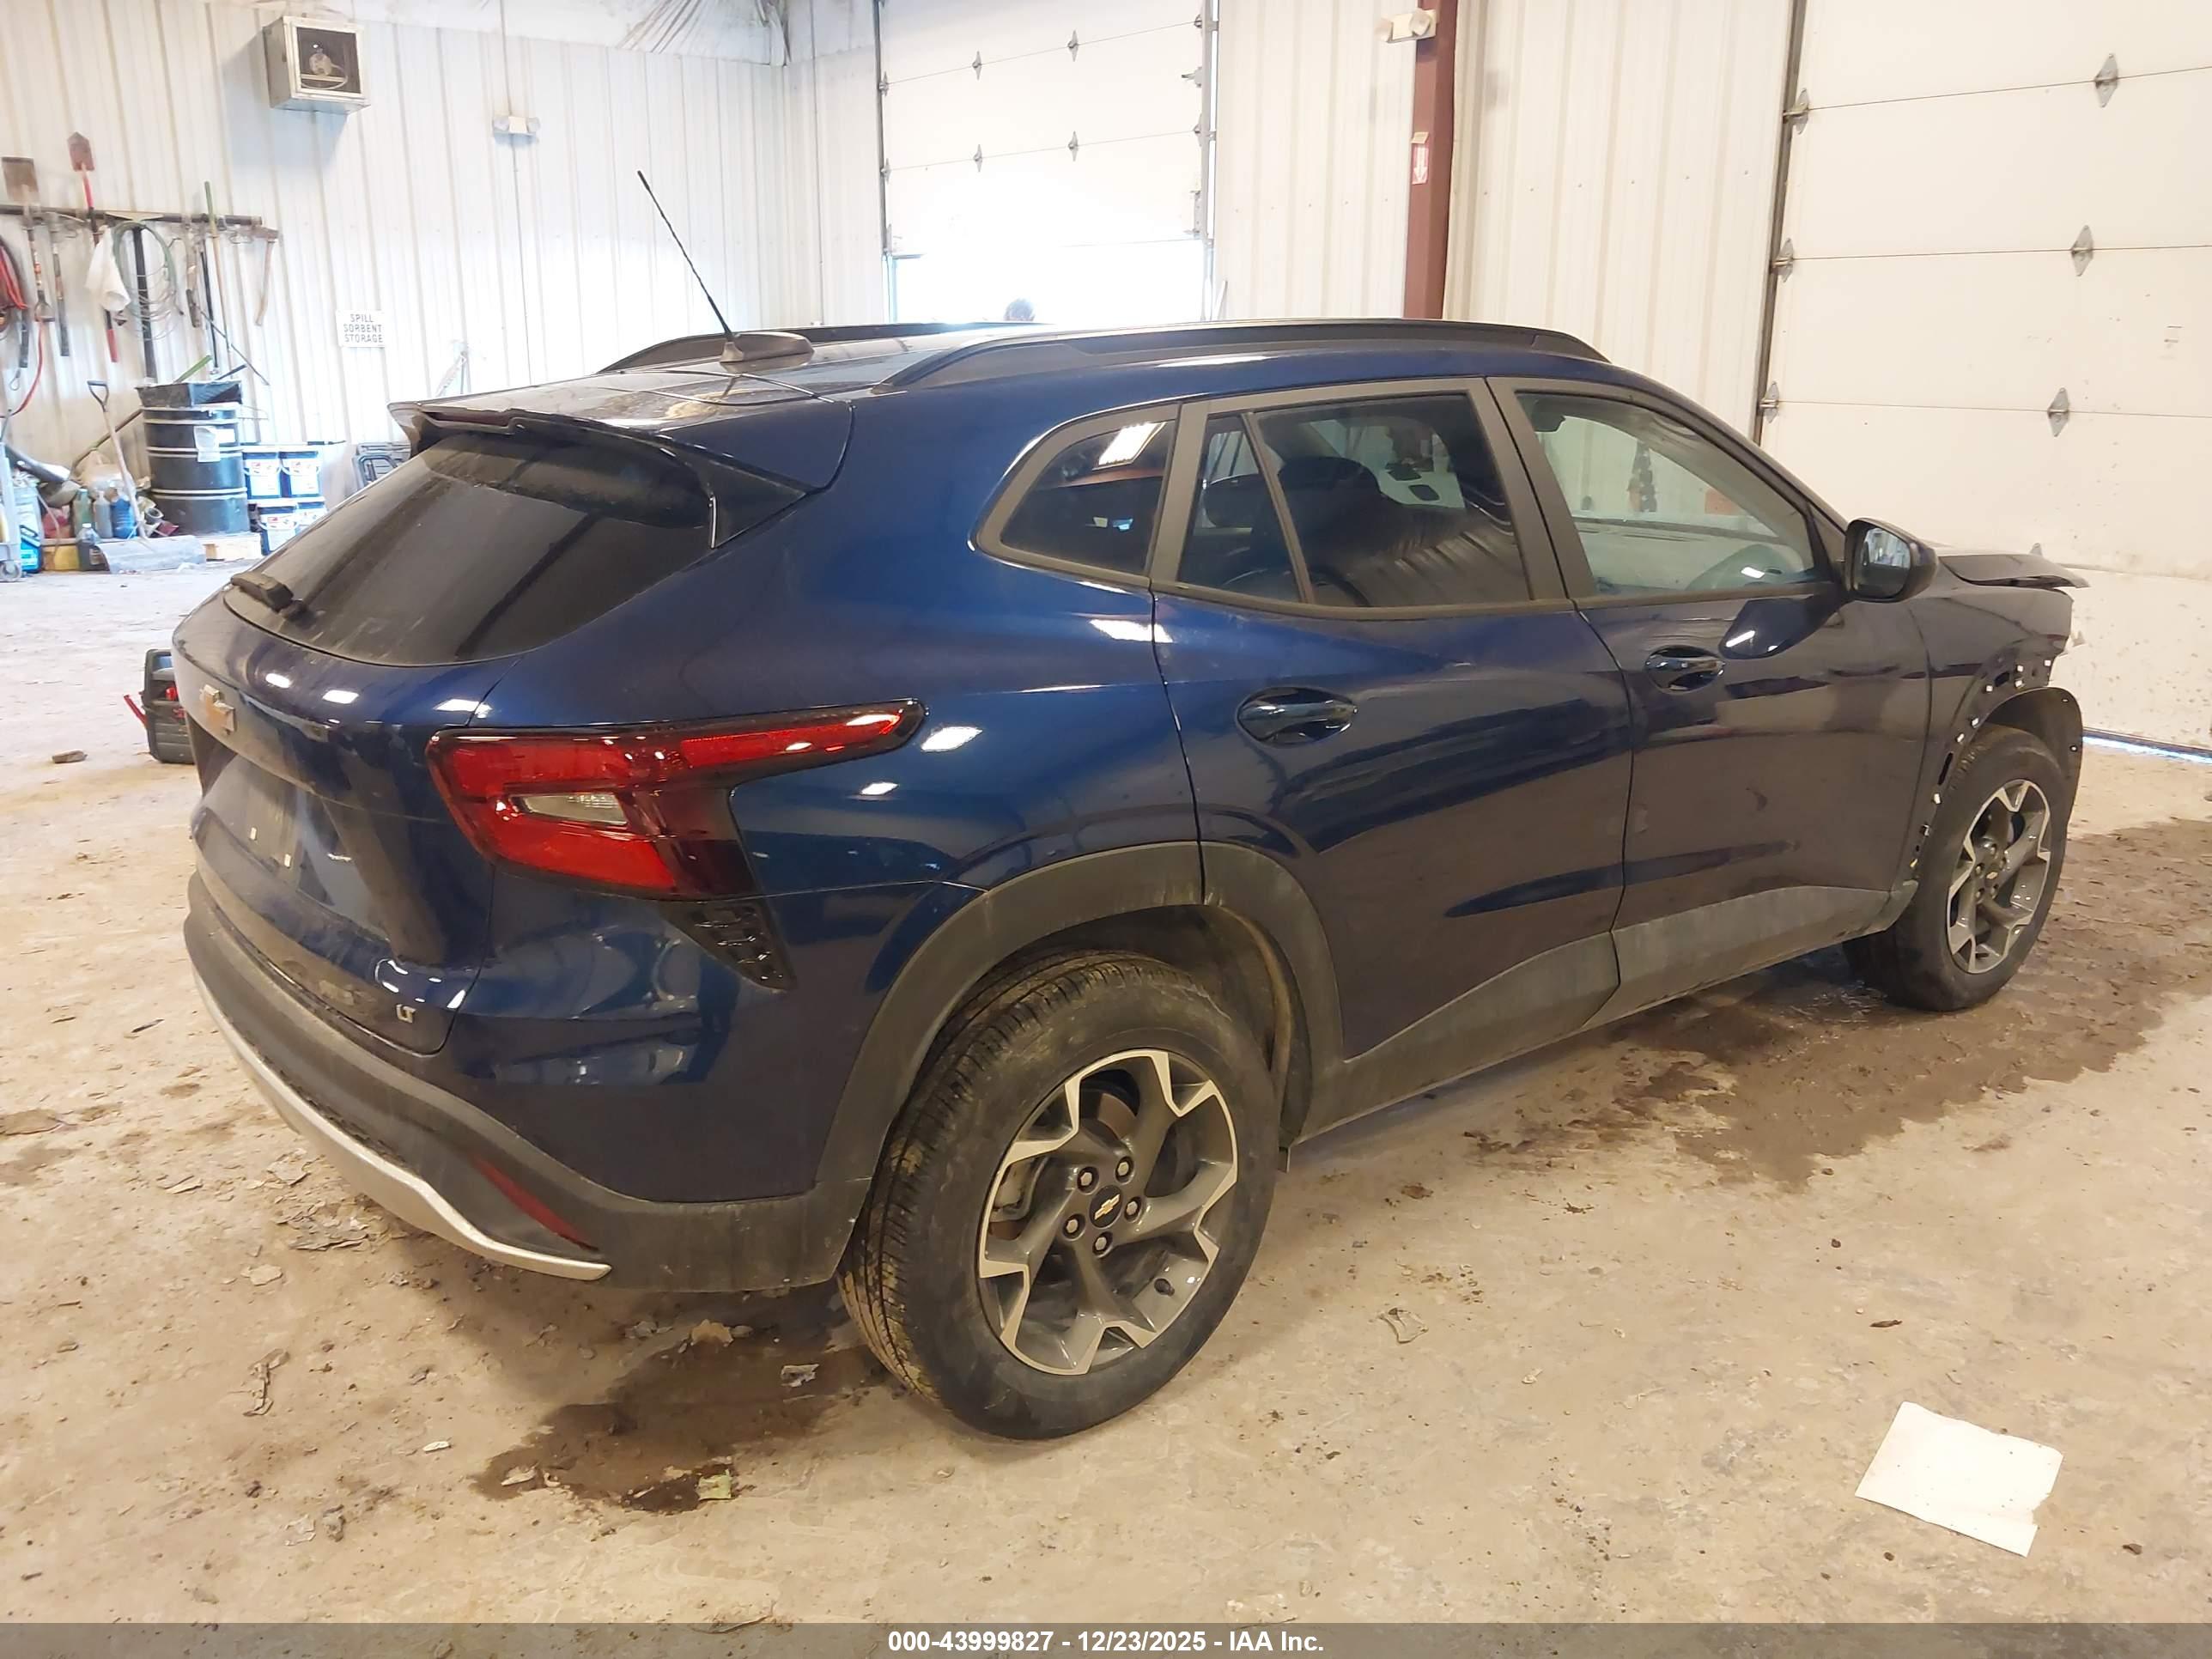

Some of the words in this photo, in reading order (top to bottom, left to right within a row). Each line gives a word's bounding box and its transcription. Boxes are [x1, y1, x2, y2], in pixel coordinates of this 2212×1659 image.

[349, 313, 374, 323] SPILL
[343, 324, 382, 333] SORBENT
[344, 334, 383, 343] STORAGE
[396, 1004, 416, 1024] LT
